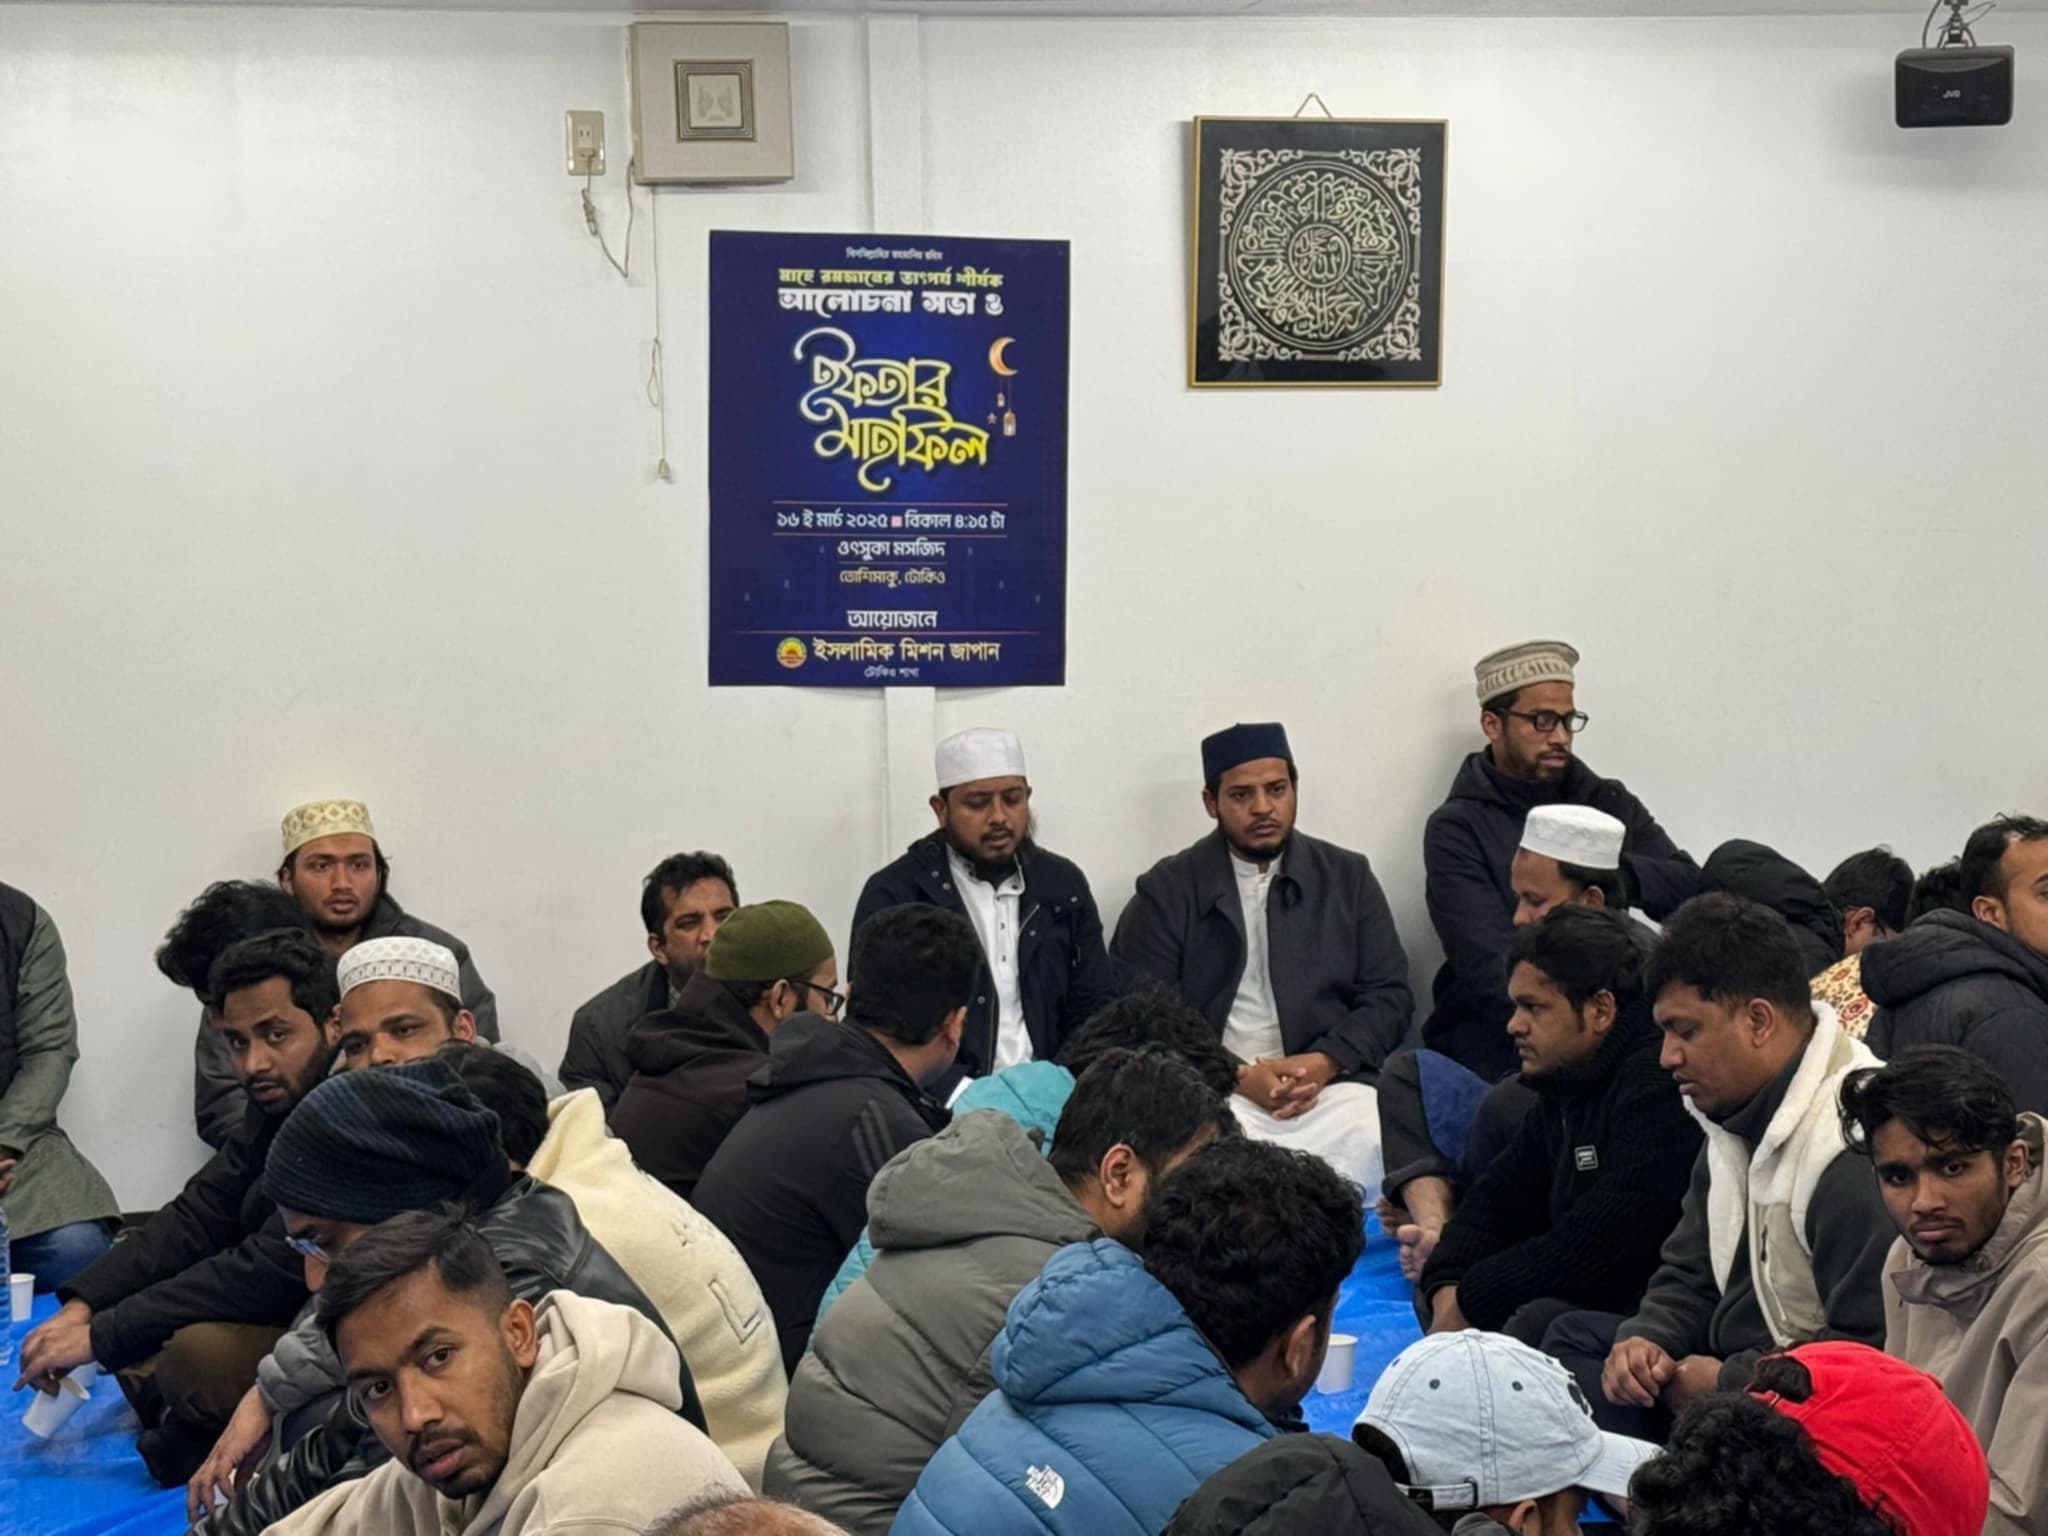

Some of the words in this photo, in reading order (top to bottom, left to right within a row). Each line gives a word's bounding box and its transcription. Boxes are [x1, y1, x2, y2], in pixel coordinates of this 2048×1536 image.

[778, 268, 815, 286] মাহে
[819, 269, 896, 288] রমজানের
[899, 265, 953, 286] তাৎপর্য
[955, 265, 1004, 288] শীর্ষক
[777, 287, 914, 319] আলোচনা
[921, 290, 977, 316] সভা
[984, 292, 1004, 316] ও
[794, 326, 952, 421] ইফতার
[812, 397, 990, 492] মাহফিল
[776, 511, 800, 528] ১৬
[802, 508, 815, 529] ই
[816, 507, 844, 528] মার্চ
[846, 512, 889, 529] ২০২৫
[905, 508, 952, 529] বিকাল
[954, 513, 989, 529] ৪:১৫
[990, 510, 1006, 529] টা
[837, 540, 891, 561] ওৎসুকা
[893, 536, 947, 557] মসজিদ
[904, 567, 946, 584] টোকিও
[846, 610, 938, 631] আয়োজনে
[812, 636, 896, 662] ইসলামিক
[899, 636, 946, 662] মিশন
[948, 640, 1001, 662] জাপান
